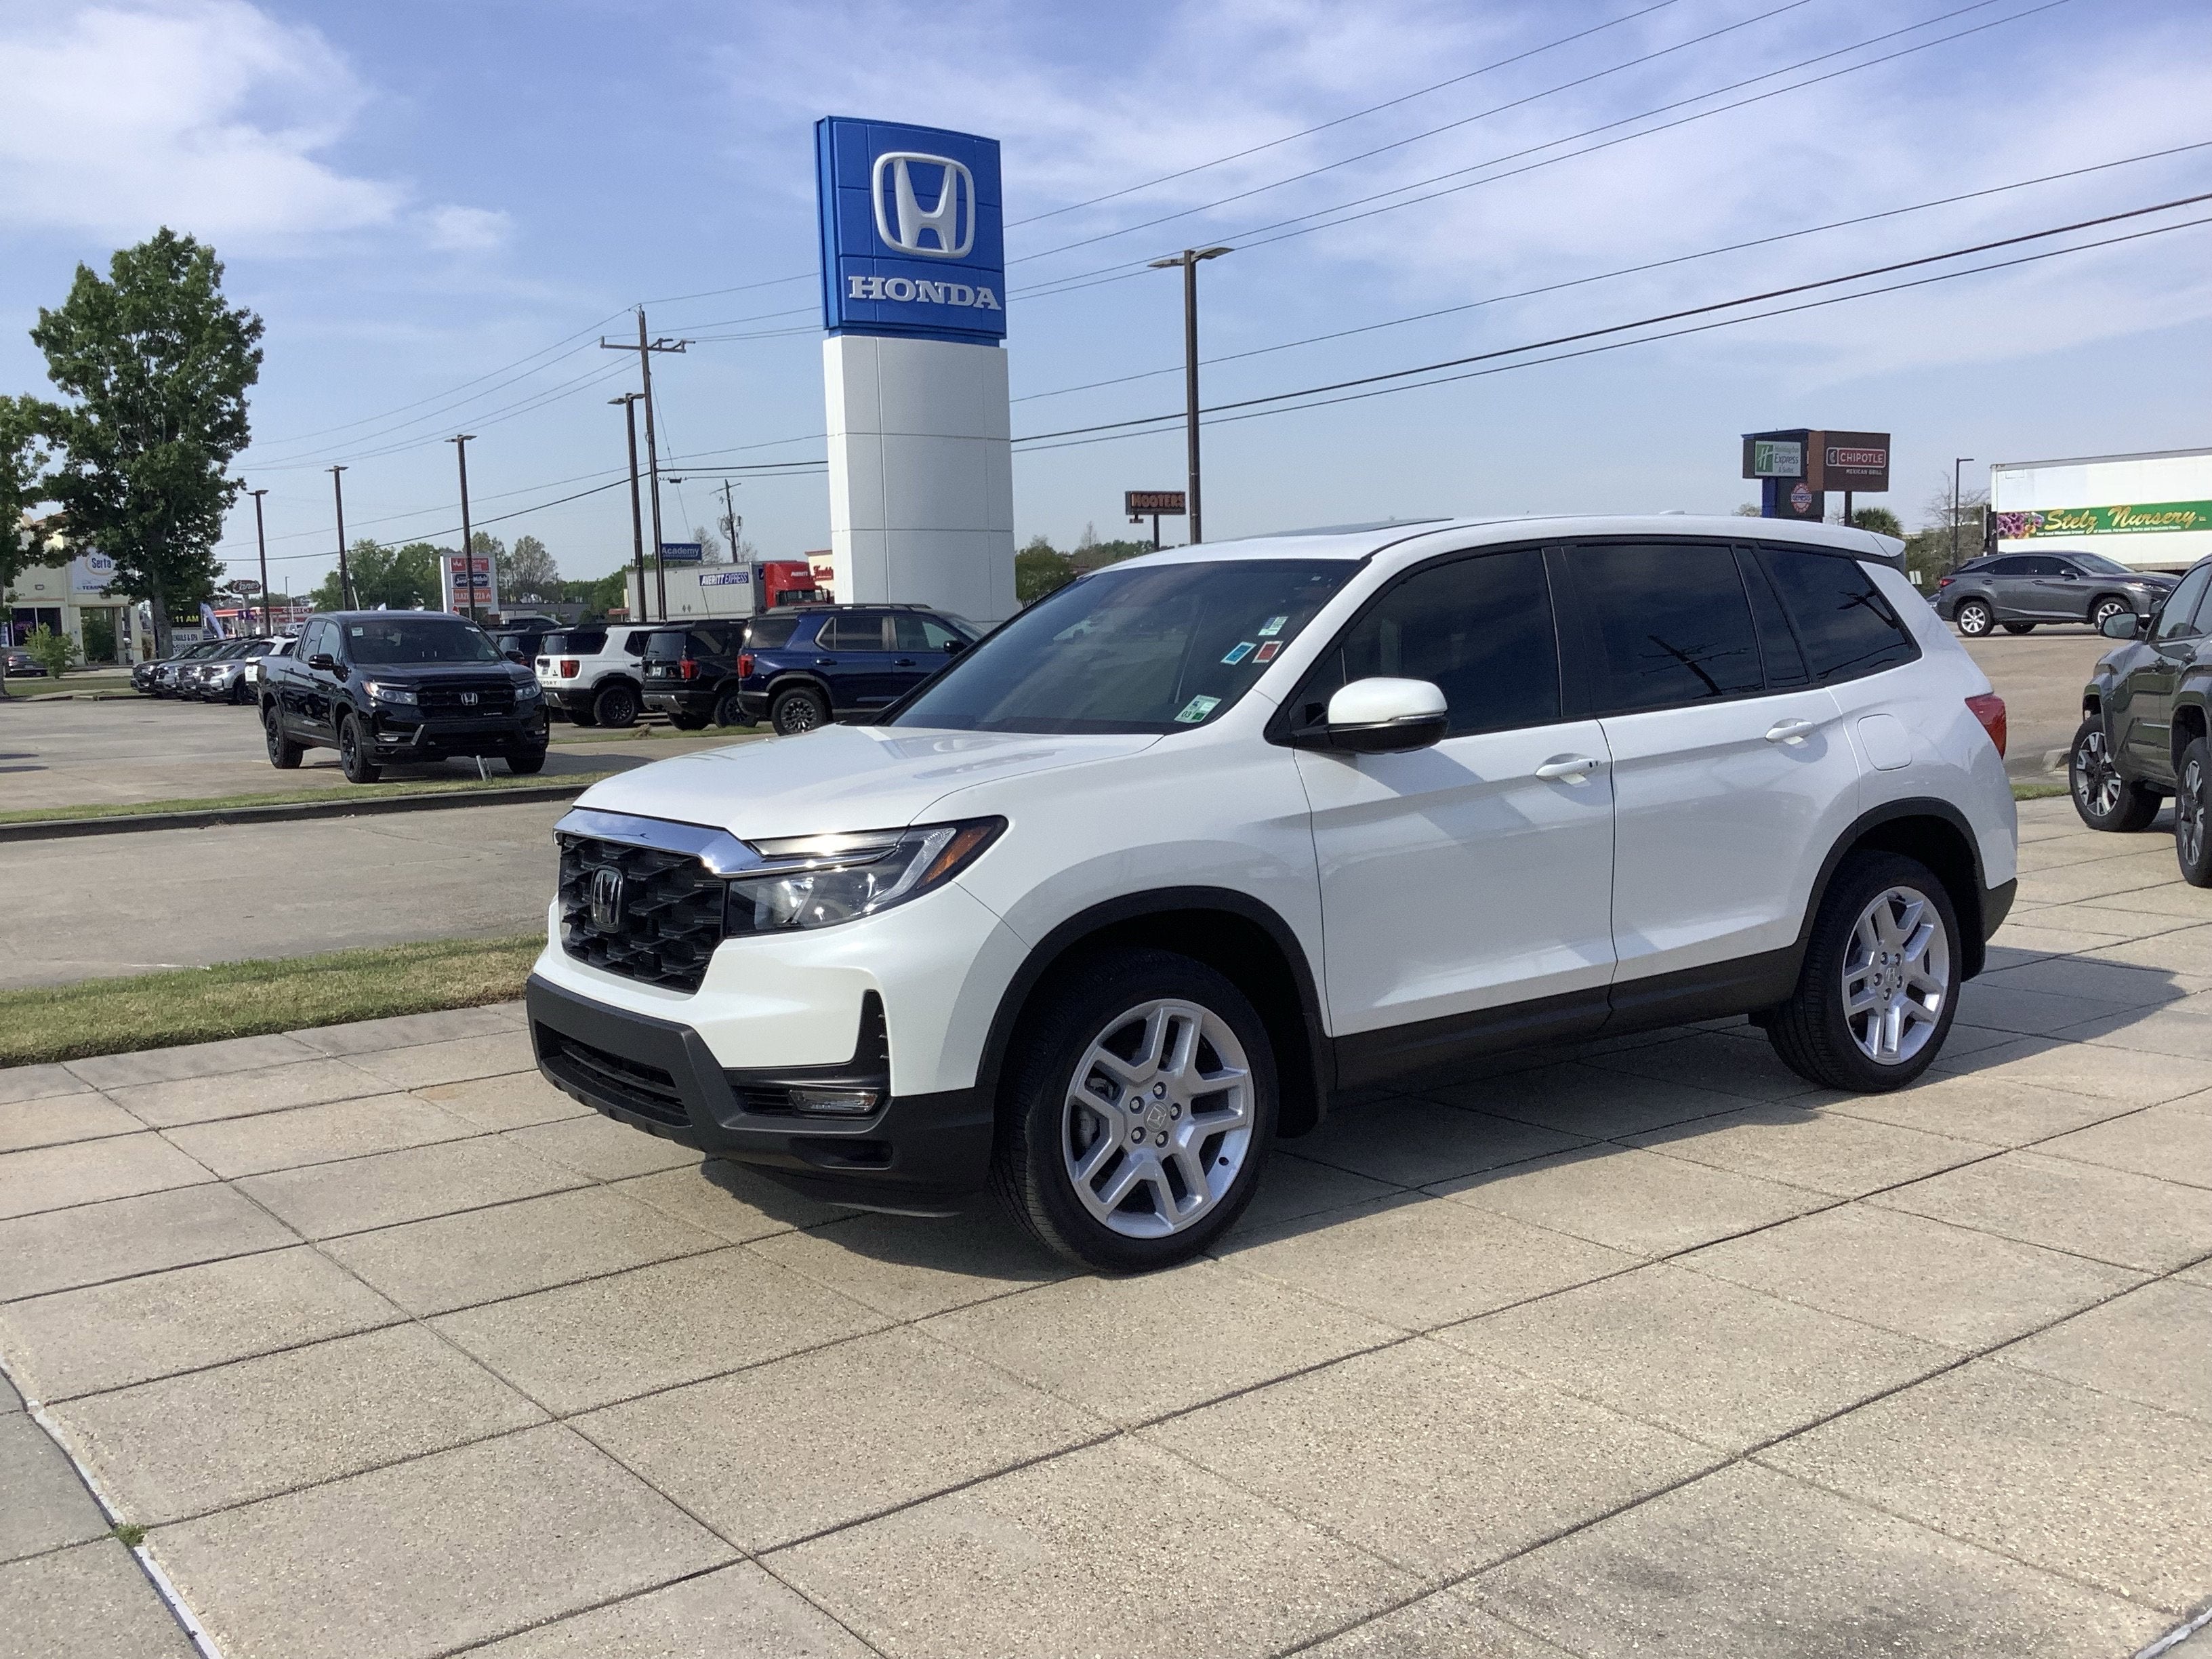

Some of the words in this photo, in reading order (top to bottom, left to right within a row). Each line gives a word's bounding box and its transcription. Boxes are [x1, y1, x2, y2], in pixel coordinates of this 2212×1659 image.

[848, 276, 1002, 310] HONDA
[1775, 453, 1799, 466] Express
[1840, 453, 1883, 464] CHIPOTLE
[1131, 493, 1184, 508] HOOTERS
[2045, 510, 2098, 534] Stelz
[2108, 506, 2196, 529] Nursery
[662, 547, 699, 556] Academy
[91, 558, 111, 568] Serta
[701, 575, 724, 586] AVERITT
[724, 573, 747, 583] EXPRESS
